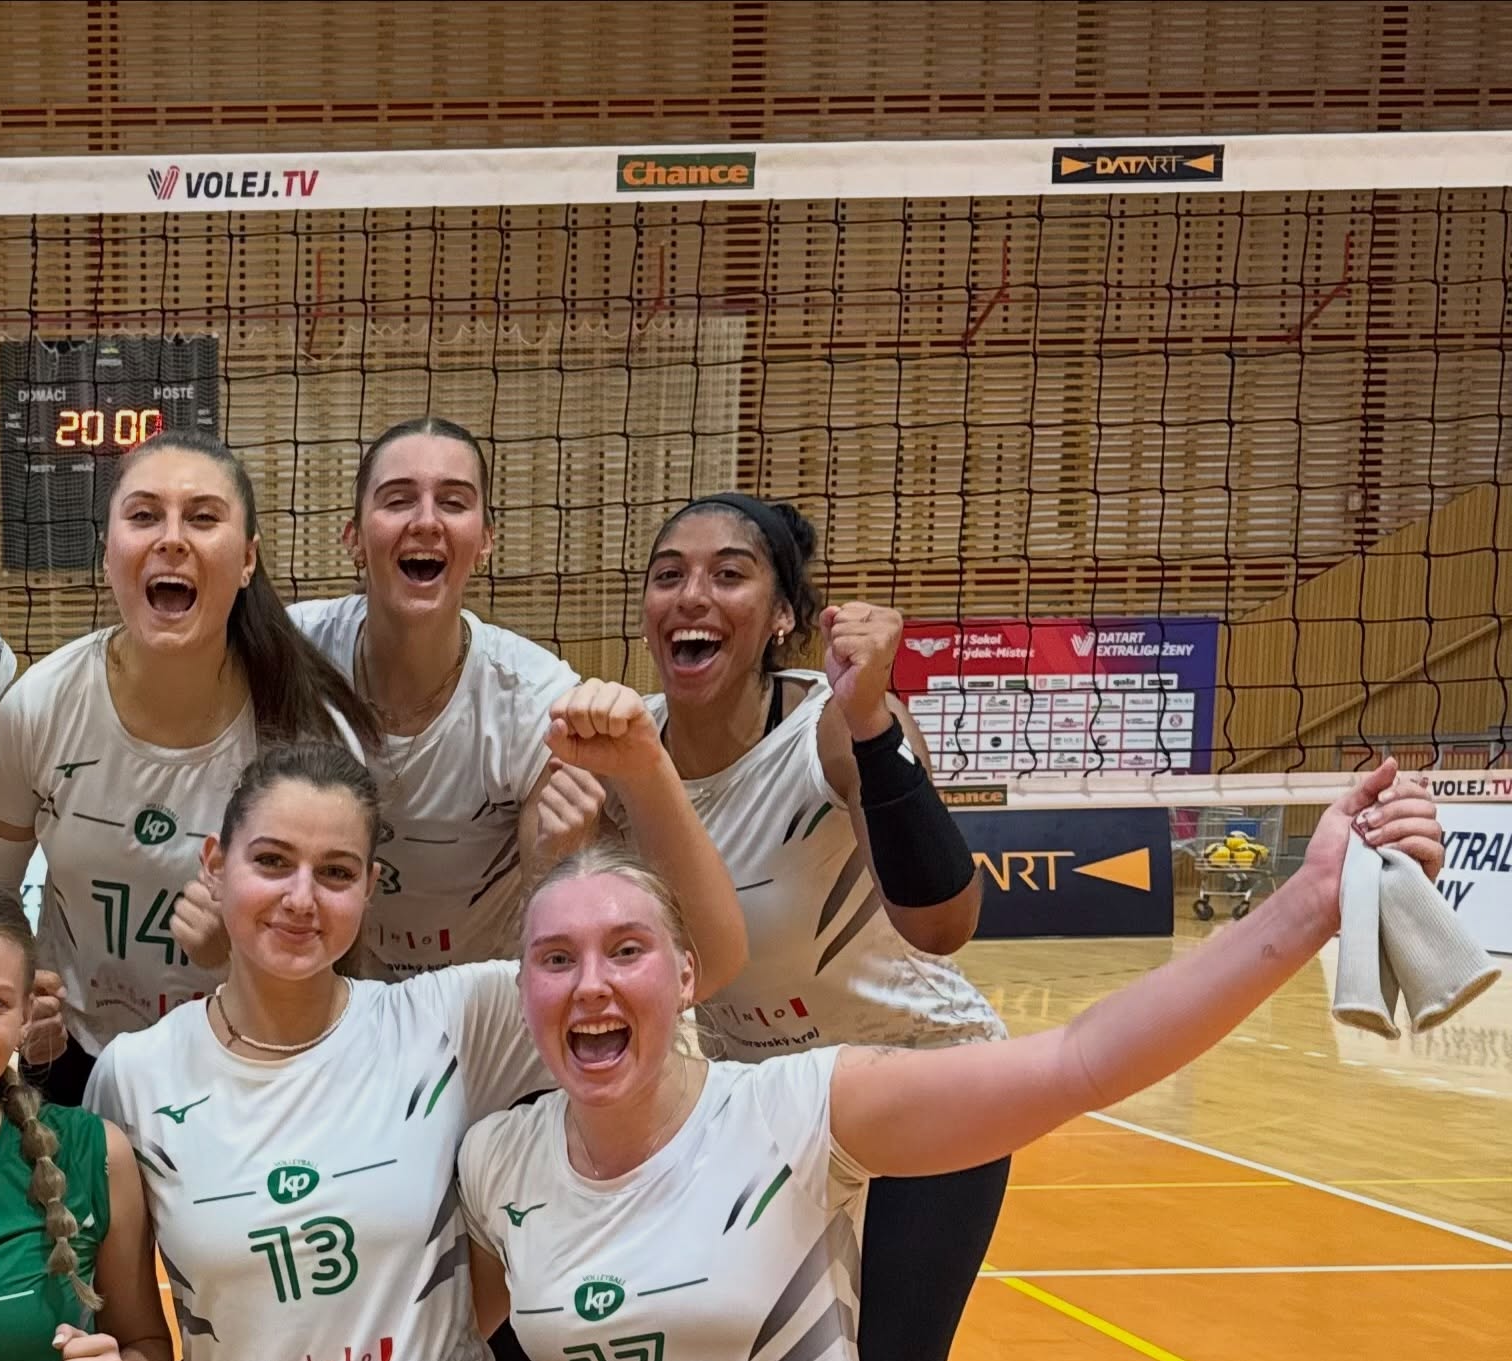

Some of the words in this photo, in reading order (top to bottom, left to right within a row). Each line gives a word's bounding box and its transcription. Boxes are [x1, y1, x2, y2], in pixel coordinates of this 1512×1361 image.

[623, 160, 748, 186] Chance
[1096, 156, 1182, 175] DATART
[187, 170, 318, 199] VOLEJ.TV
[1096, 645, 1159, 656] EXTRALIGA
[1162, 641, 1194, 656] ŽENY
[1099, 632, 1145, 643] DATART
[91, 879, 189, 967] 14
[278, 1170, 311, 1199] kp
[248, 1215, 359, 1303] 13
[584, 1286, 616, 1315] kp
